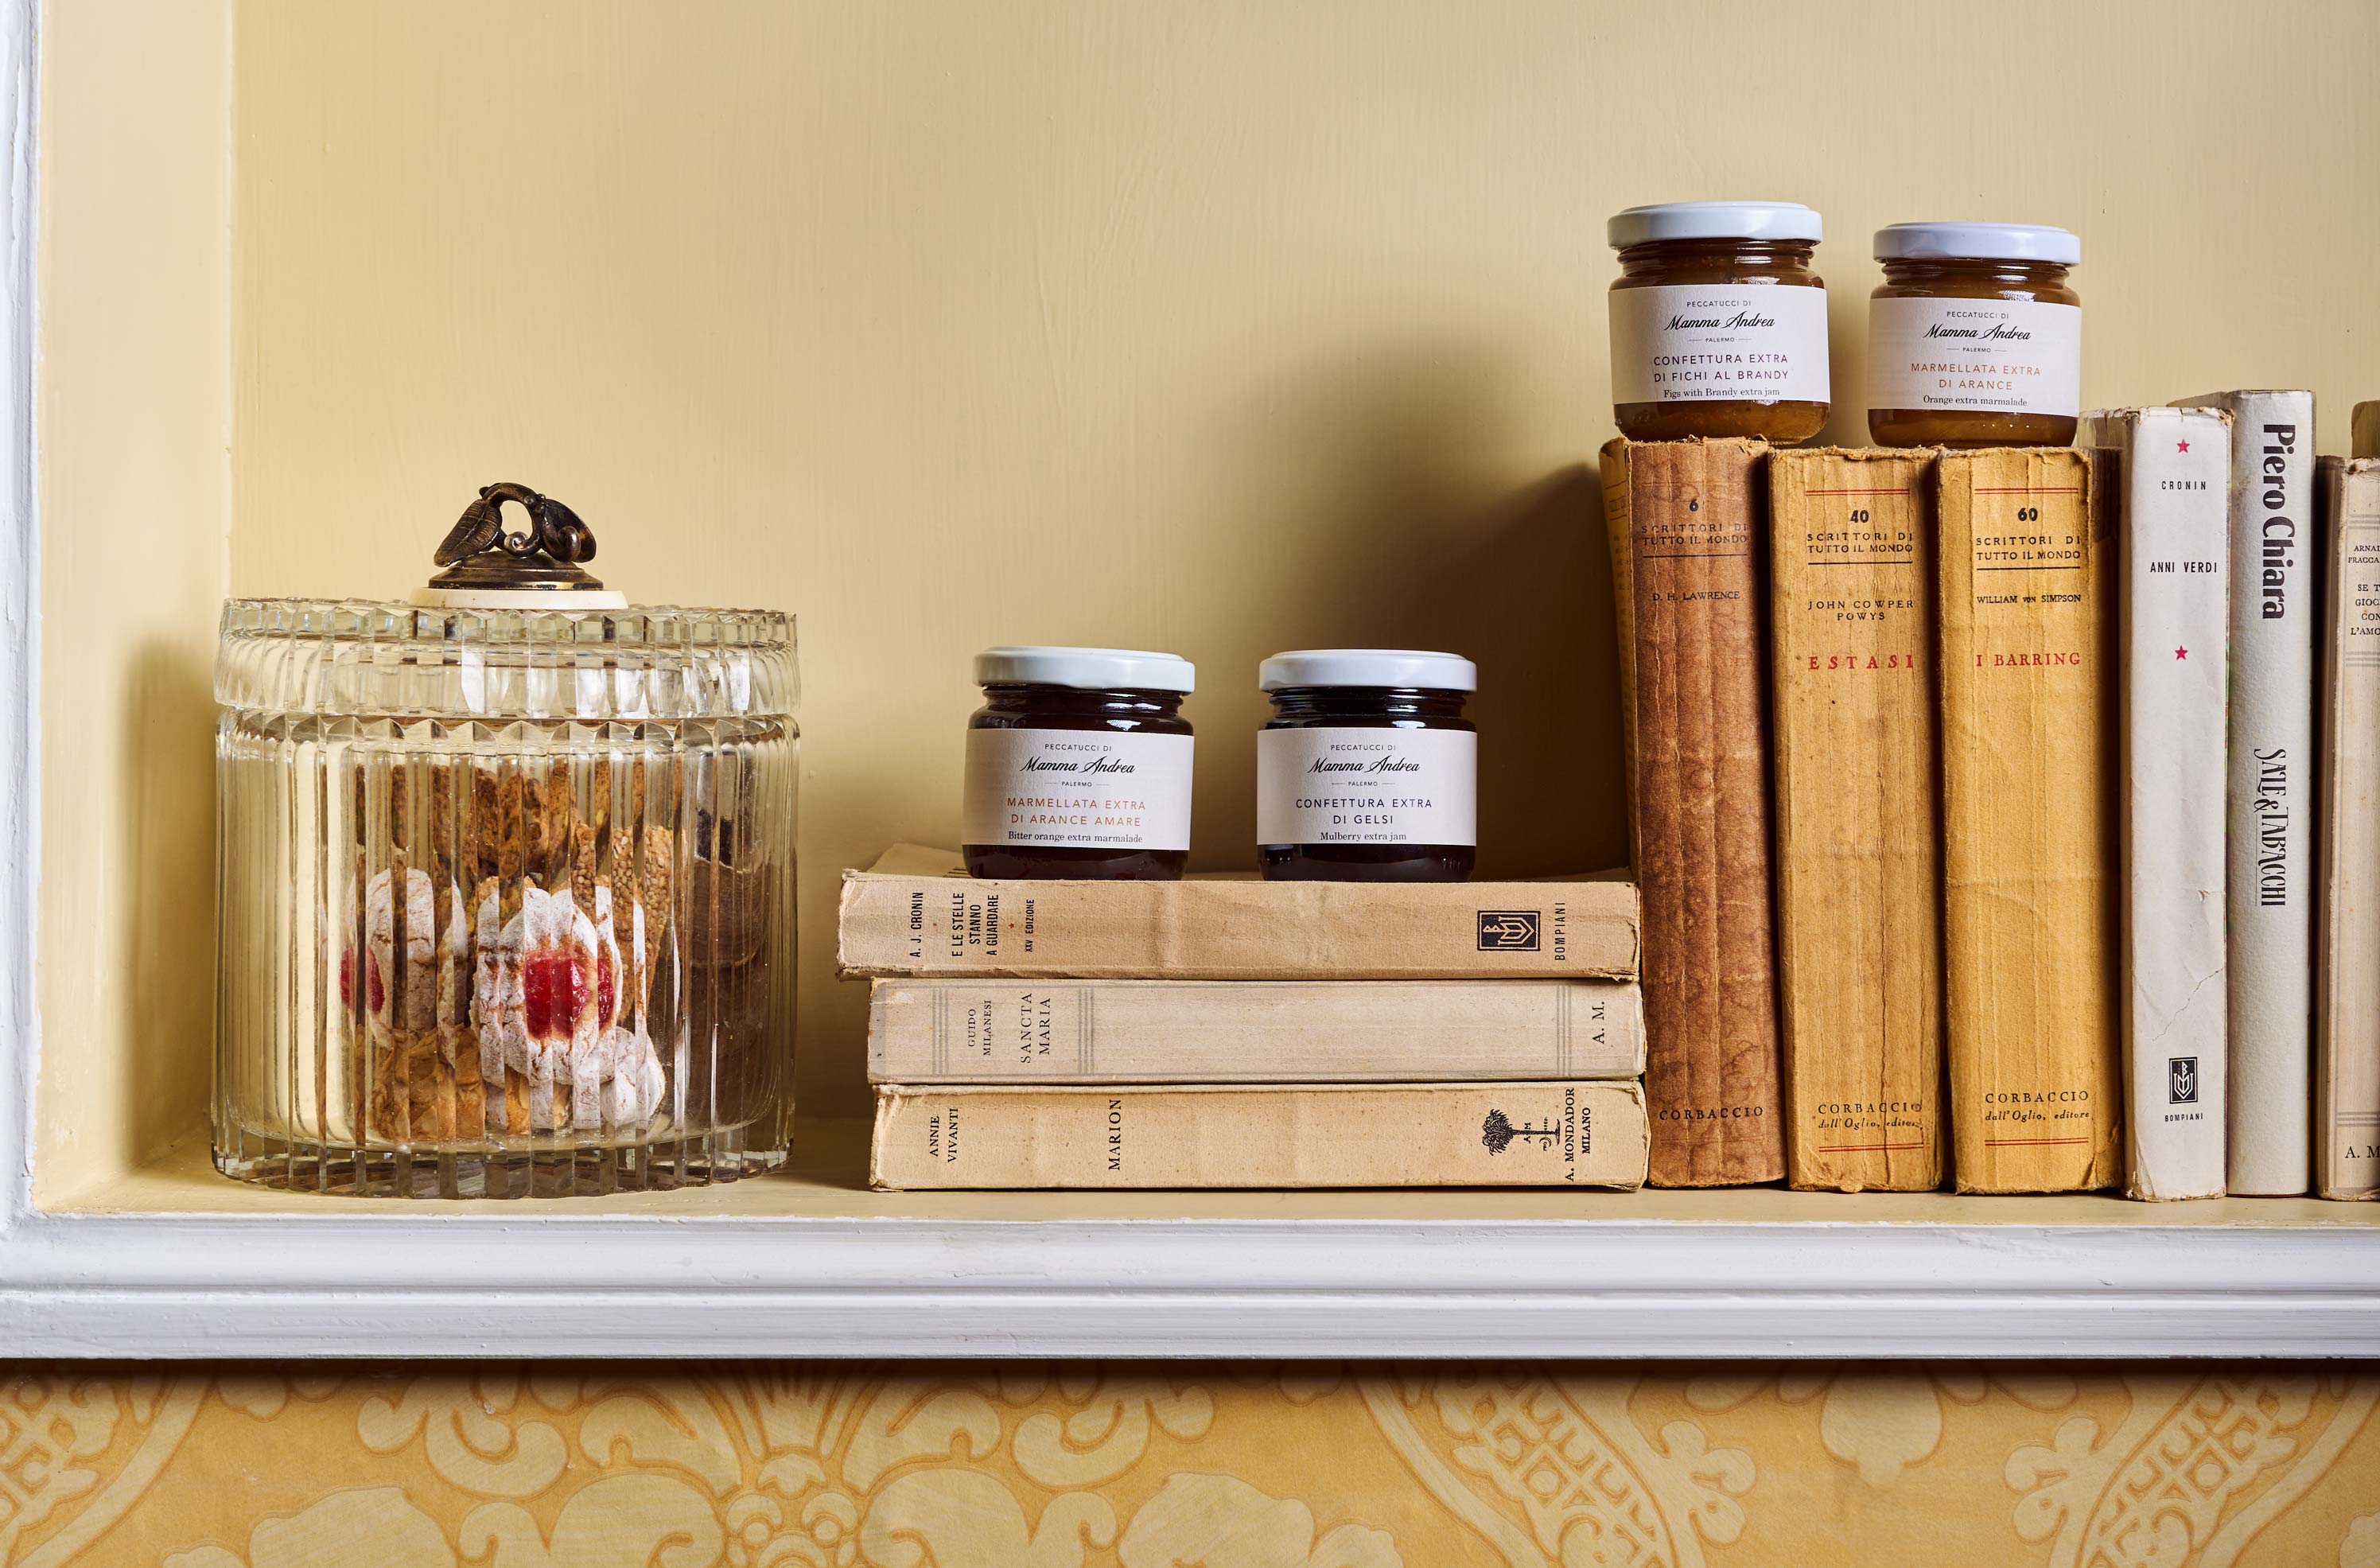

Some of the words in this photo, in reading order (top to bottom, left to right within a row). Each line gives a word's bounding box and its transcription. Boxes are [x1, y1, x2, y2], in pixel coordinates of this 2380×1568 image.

[1664, 314, 1721, 330] Mamma
[1721, 310, 1775, 330] Andrea
[1923, 323, 1978, 339] Mamma
[1978, 323, 2031, 341] Andrea
[1654, 355, 1742, 366] CONFETTURA
[1749, 354, 1788, 364] EXTRA
[1911, 363, 1997, 374] MARMELLATA
[2003, 365, 2040, 375] EXTRA
[1655, 373, 1666, 383] DI
[1672, 372, 1707, 381] FICHI
[1714, 371, 1731, 380] AL
[1738, 371, 1788, 380] BRANDY
[1939, 379, 1951, 388] DI
[1958, 380, 2012, 391] ARANCE
[1663, 389, 1681, 399] Figs
[1683, 388, 1703, 397] with
[1705, 387, 1738, 398] Brandy
[1764, 387, 1780, 397] jam
[1923, 395, 1953, 405] Orange
[1981, 398, 2028, 407] marmalade
[2262, 424, 2296, 511] Piero
[2161, 481, 2207, 491] CRONIN
[1689, 499, 1699, 512] 6
[1849, 510, 1869, 523] 40
[2017, 508, 2038, 522] 60
[1641, 523, 1723, 534] SCRITTORI
[1734, 523, 1747, 531] DI
[1643, 536, 1684, 546] TUTTO
[1706, 535, 1748, 544] MONDO
[1806, 532, 1888, 542] SCRITTORI
[1898, 532, 1913, 542] DI
[1976, 536, 2052, 546] SCRITTORI
[2066, 536, 2081, 545] DI
[1853, 544, 1865, 553] IL
[1869, 544, 1913, 553] MONDO
[1977, 551, 2018, 560] TUTTO
[2023, 551, 2034, 560] IL
[2037, 551, 2081, 559] MONDO
[2150, 561, 2176, 574] ANNI
[2184, 561, 2218, 574] VERDI
[2262, 516, 2296, 620] Chiara
[1652, 593, 1663, 601] D.
[1682, 591, 1740, 601] LAWRENCE
[1977, 595, 2018, 604] WILLIAM
[2041, 594, 2082, 603] SIMPSON
[1808, 601, 1845, 610] JOHN
[1853, 600, 1914, 609] COWPER
[1837, 612, 1885, 621] POWYS
[1808, 655, 1914, 670] ESTASI
[1976, 655, 1983, 667] I
[1994, 652, 2081, 667] BARRING
[1044, 743, 1099, 752] PECCATUCCI
[1020, 756, 1079, 772] Mamma
[1078, 756, 1136, 775] Andrea
[1307, 757, 1364, 773] Mamma
[1363, 755, 1421, 775] Andrea
[2254, 749, 2287, 796] SALE
[1007, 797, 1098, 809] MARMELLATA
[1105, 800, 1146, 810] EXTRA
[1296, 799, 1385, 808] CONFETTURA
[1392, 799, 1433, 808] EXTRA
[2254, 799, 2279, 813] &
[1011, 814, 1024, 823] DI
[1030, 815, 1087, 825] ARANCE
[1095, 816, 1141, 827] AMARE
[1333, 815, 1347, 824] DI
[1354, 815, 1394, 824] GELSI
[1008, 831, 1032, 840] Bitter
[1034, 834, 1065, 842] orange
[1095, 835, 1143, 843] marmalade
[1320, 831, 1361, 842] Mulberry
[1389, 832, 1406, 842] jam
[2258, 807, 2289, 907] TABACCHI
[911, 892, 924, 930] CRONIN
[952, 893, 964, 931] STELLE
[1025, 899, 1035, 934] EDIZIONE
[969, 904, 982, 944] STANNO
[986, 894, 999, 946] GUARDARE
[1554, 901, 1566, 961] BOMPIANI
[911, 934, 922, 944] J.
[952, 934, 963, 947] LE
[909, 948, 921, 958] A.
[1025, 940, 1033, 953] XXV
[1592, 1001, 1605, 1021] M.
[967, 1009, 977, 1047] GUIDO
[983, 1000, 992, 1056] MILANESI
[1021, 993, 1032, 1064] SANCTA
[1039, 998, 1051, 1056] MARIA
[1592, 1027, 1605, 1045] A.
[1985, 1091, 2089, 1103] CORBACCIO
[1659, 1106, 1764, 1121] CORBACCIO
[1818, 1102, 1923, 1115] CORBACCIO
[1985, 1110, 2010, 1121] dall'
[2012, 1109, 2047, 1123] Oglio,
[2164, 1113, 2203, 1123] BOMPIANI
[1844, 1117, 1880, 1130] Oglio,
[929, 1115, 940, 1158] ANNIE
[947, 1107, 959, 1163] VIVANTI
[1108, 1099, 1122, 1171] MARION
[1582, 1107, 1591, 1154] MILANO
[1523, 1135, 1531, 1144] A
[2345, 1146, 2360, 1158] A.
[1565, 1168, 1575, 1182] A.
